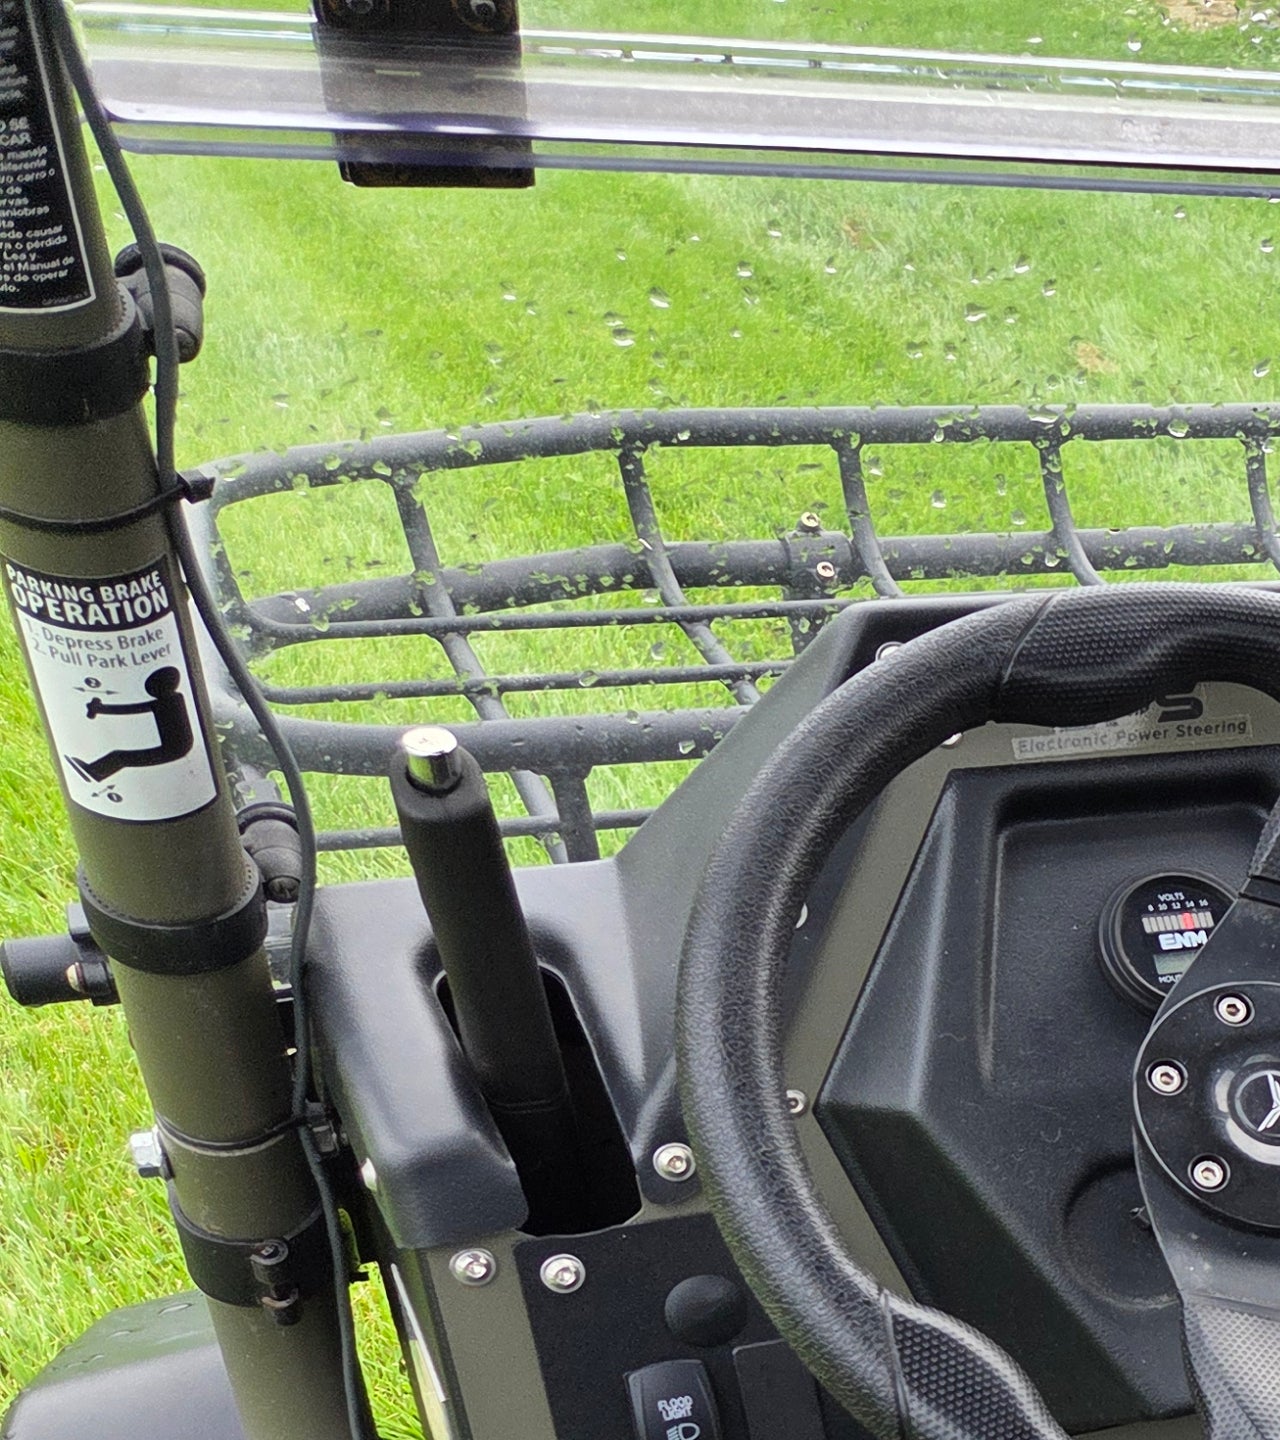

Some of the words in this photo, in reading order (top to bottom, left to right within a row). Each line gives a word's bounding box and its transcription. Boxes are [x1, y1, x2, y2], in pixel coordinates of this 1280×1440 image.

[6, 564, 95, 603] PARKING
[100, 570, 163, 602] BRAKE
[11, 582, 170, 626] OPERATION
[43, 625, 114, 652] Depress
[117, 626, 164, 650] Brake
[49, 643, 83, 667] Pull
[87, 654, 128, 669] Park
[131, 643, 174, 667] Lever
[1017, 734, 1107, 754] Electronic
[1116, 726, 1169, 744] Power
[1175, 719, 1248, 739] Steering
[1158, 892, 1185, 902] VOLTS
[1171, 902, 1182, 910] 12
[1158, 930, 1208, 951] ENM
[657, 1395, 693, 1412] FLOOD
[662, 1407, 692, 1421] LIGHT
